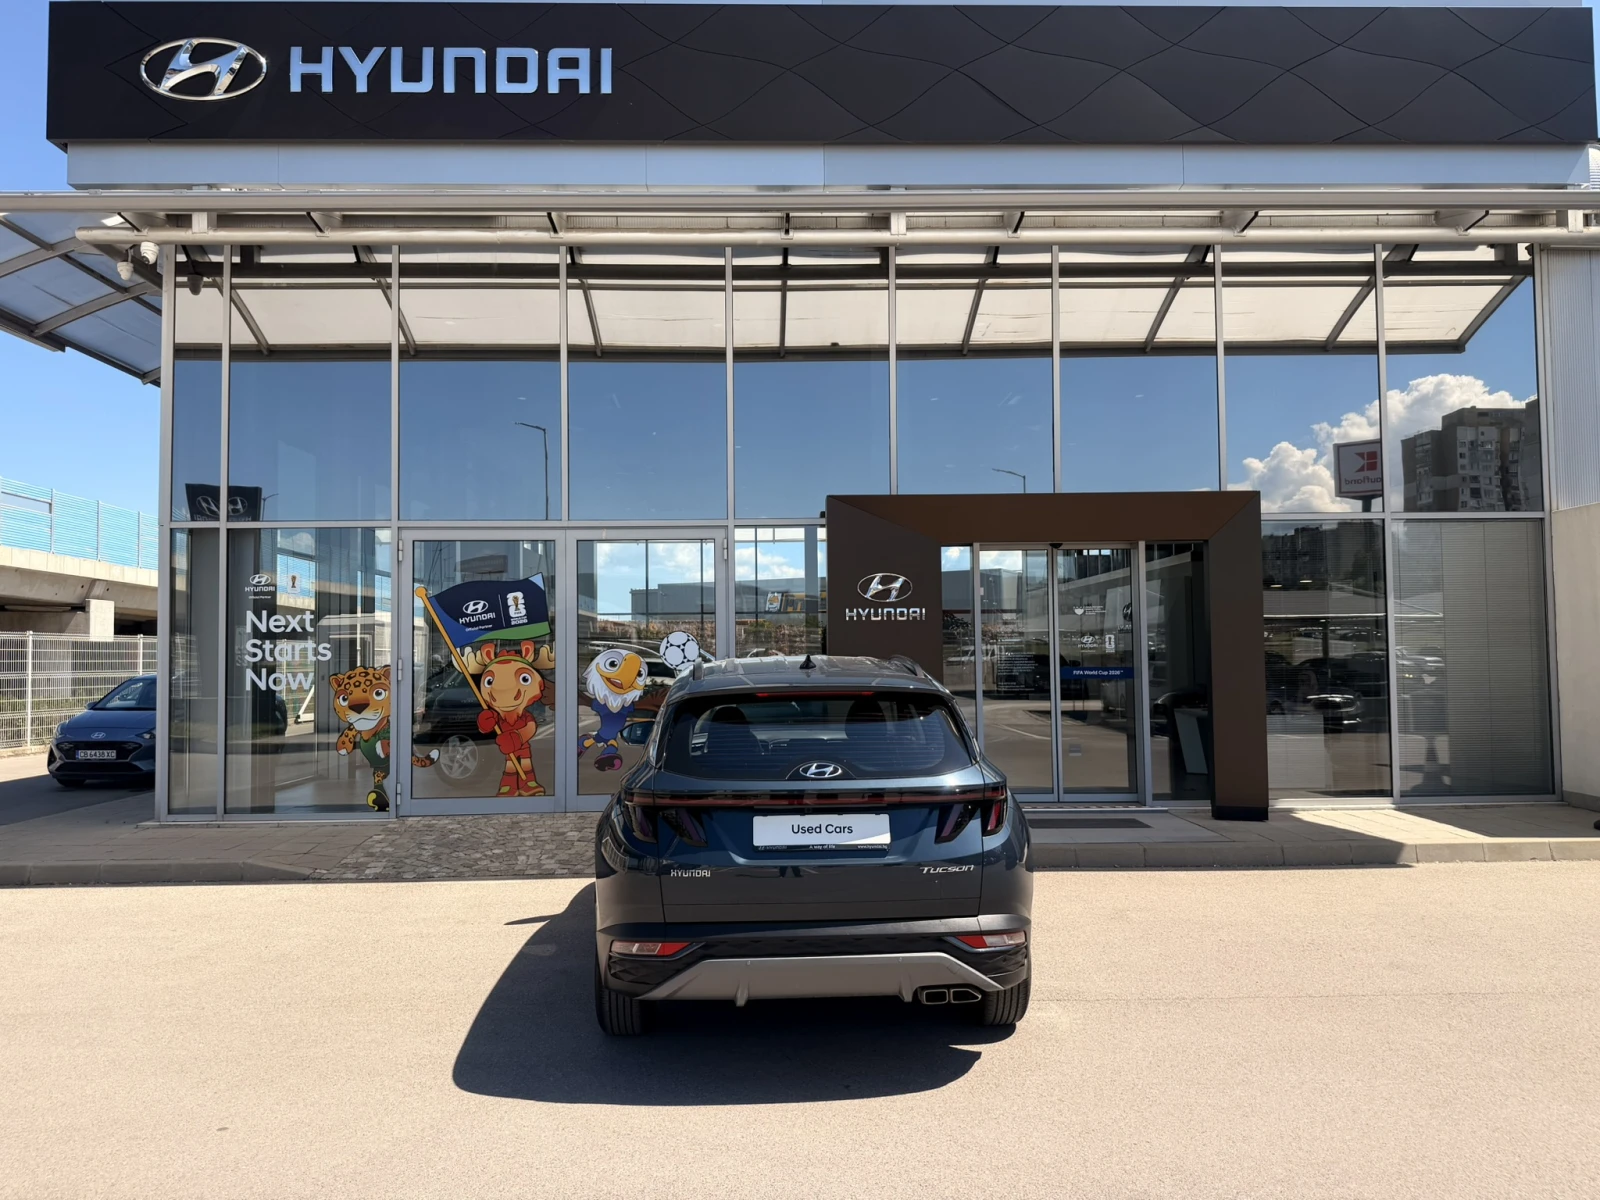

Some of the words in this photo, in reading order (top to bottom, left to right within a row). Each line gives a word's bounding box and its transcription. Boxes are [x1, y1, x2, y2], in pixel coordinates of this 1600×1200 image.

[290, 46, 612, 94] HYUNDAI
[246, 610, 314, 633] Next
[459, 612, 496, 625] HYUNDAI
[845, 608, 926, 621] HYUNDAI
[244, 639, 332, 662] Starts
[245, 668, 314, 691] Now
[791, 823, 822, 834] Used
[825, 823, 853, 834] Cars
[670, 869, 711, 877] HYUNDAI
